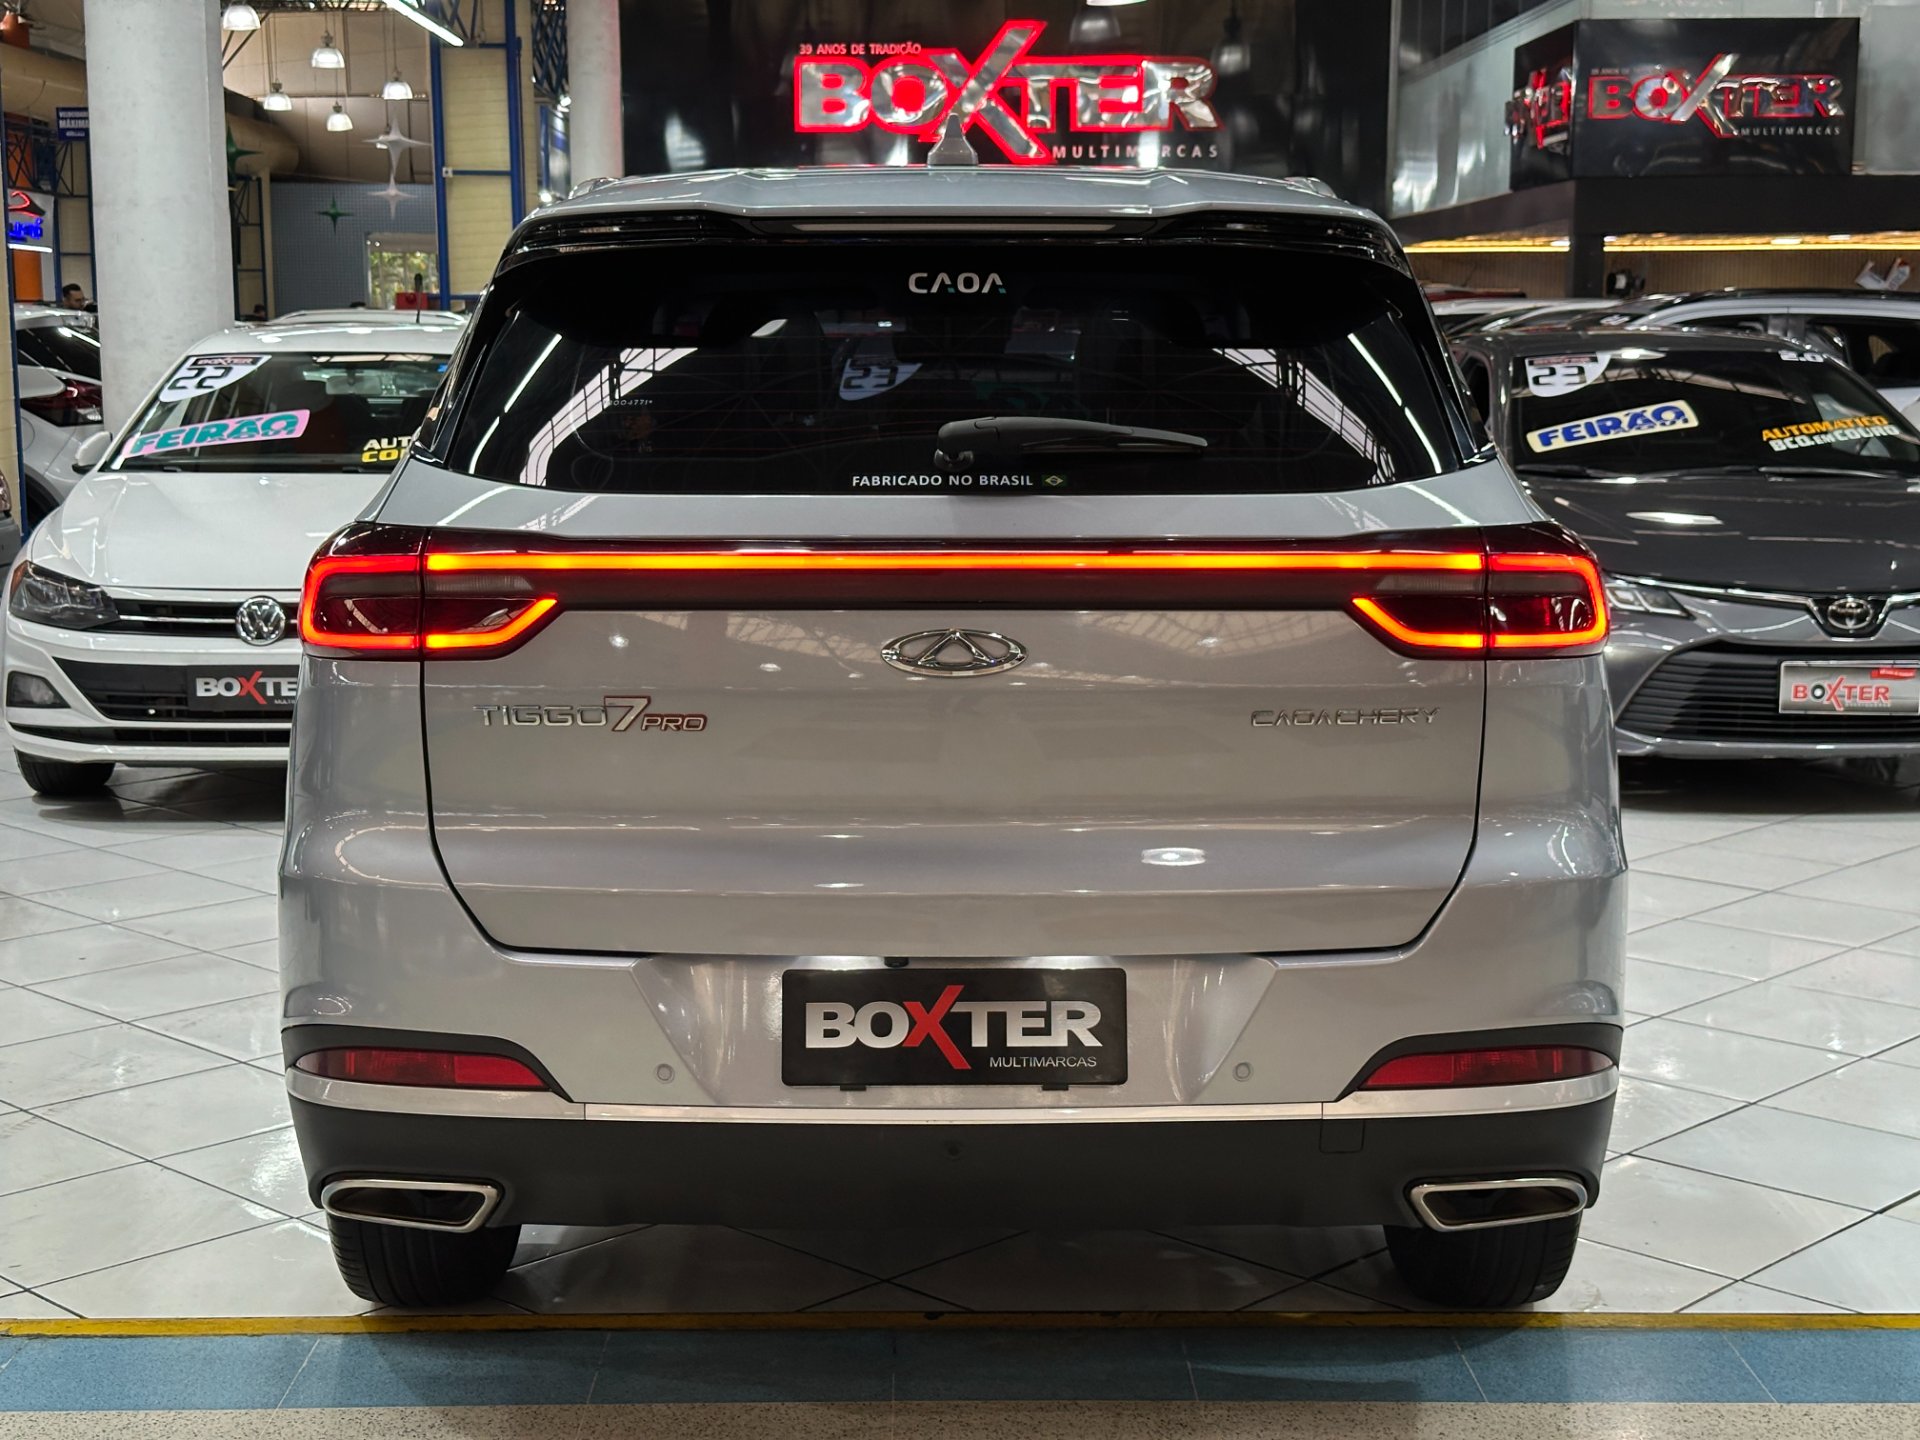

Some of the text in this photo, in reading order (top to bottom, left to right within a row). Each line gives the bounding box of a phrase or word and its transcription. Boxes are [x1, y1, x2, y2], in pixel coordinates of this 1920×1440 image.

[800, 41, 921, 55] 39 ANOS DE TRADIÇÃO
[795, 19, 1225, 163] BOXTER
[1588, 53, 1845, 138] BOXTER
[1741, 127, 1841, 137] MULTIMARCAS
[1053, 145, 1218, 158] MULTIMRCAS
[908, 272, 1007, 294] CAOA
[167, 366, 233, 390] 22
[1532, 366, 1587, 386] 23
[130, 414, 298, 454] FEIRÃO
[1537, 406, 1689, 447] FEIRÃO
[1833, 425, 1900, 441] COURO
[363, 436, 411, 451] AUT
[362, 449, 405, 462] CO
[852, 475, 1033, 487] FABRICADO NO BRASIL
[196, 671, 299, 704] BOXTE
[1791, 675, 1892, 711] BOXTER
[473, 695, 709, 732] TIGGO 7 PRO
[805, 985, 1103, 1069] BOXTER
[989, 1056, 1097, 1068] MULTIMARCAS
